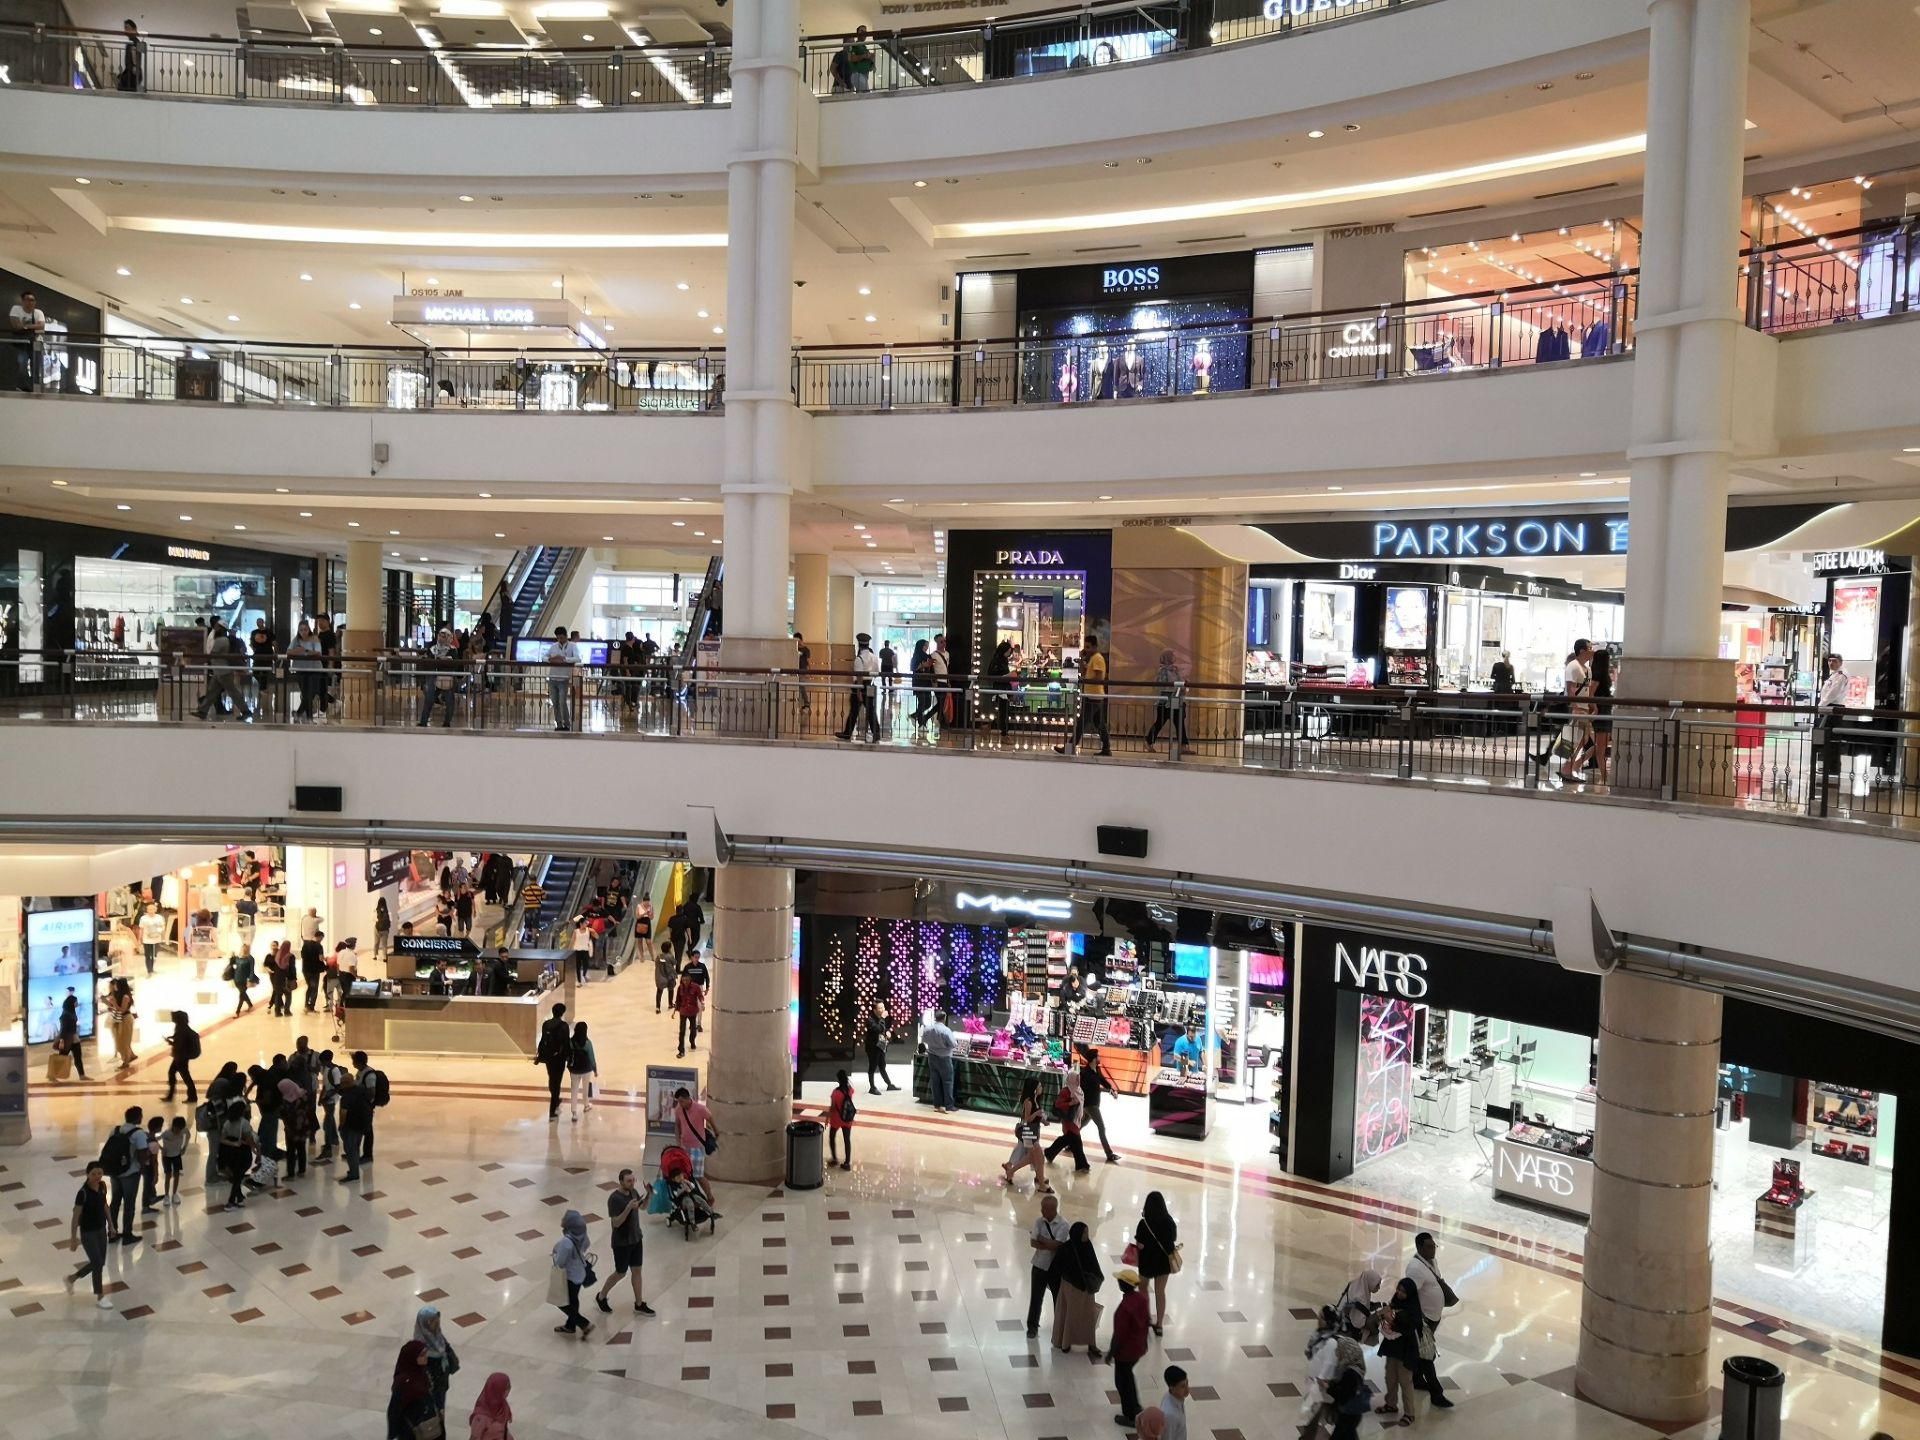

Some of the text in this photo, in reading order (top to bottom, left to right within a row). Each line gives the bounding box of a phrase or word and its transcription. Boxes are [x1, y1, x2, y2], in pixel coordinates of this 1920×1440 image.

[1103, 266, 1160, 288] BOSS
[411, 289, 463, 297] OS105 JAM
[1103, 284, 1159, 294] HUGO BOSS
[424, 306, 535, 323] MICHAEL KORS
[1342, 322, 1377, 344] CK
[1374, 521, 1584, 556] PARKSON
[995, 550, 1065, 565] PRADA
[1839, 549, 1885, 569] LAUDER
[1339, 564, 1376, 580] Dior
[1527, 581, 1543, 596] Dior
[41, 921, 84, 931] AIRism
[401, 938, 463, 950] CONCIERGE
[1334, 942, 1428, 998] NARS
[1499, 1146, 1574, 1196] NARS
